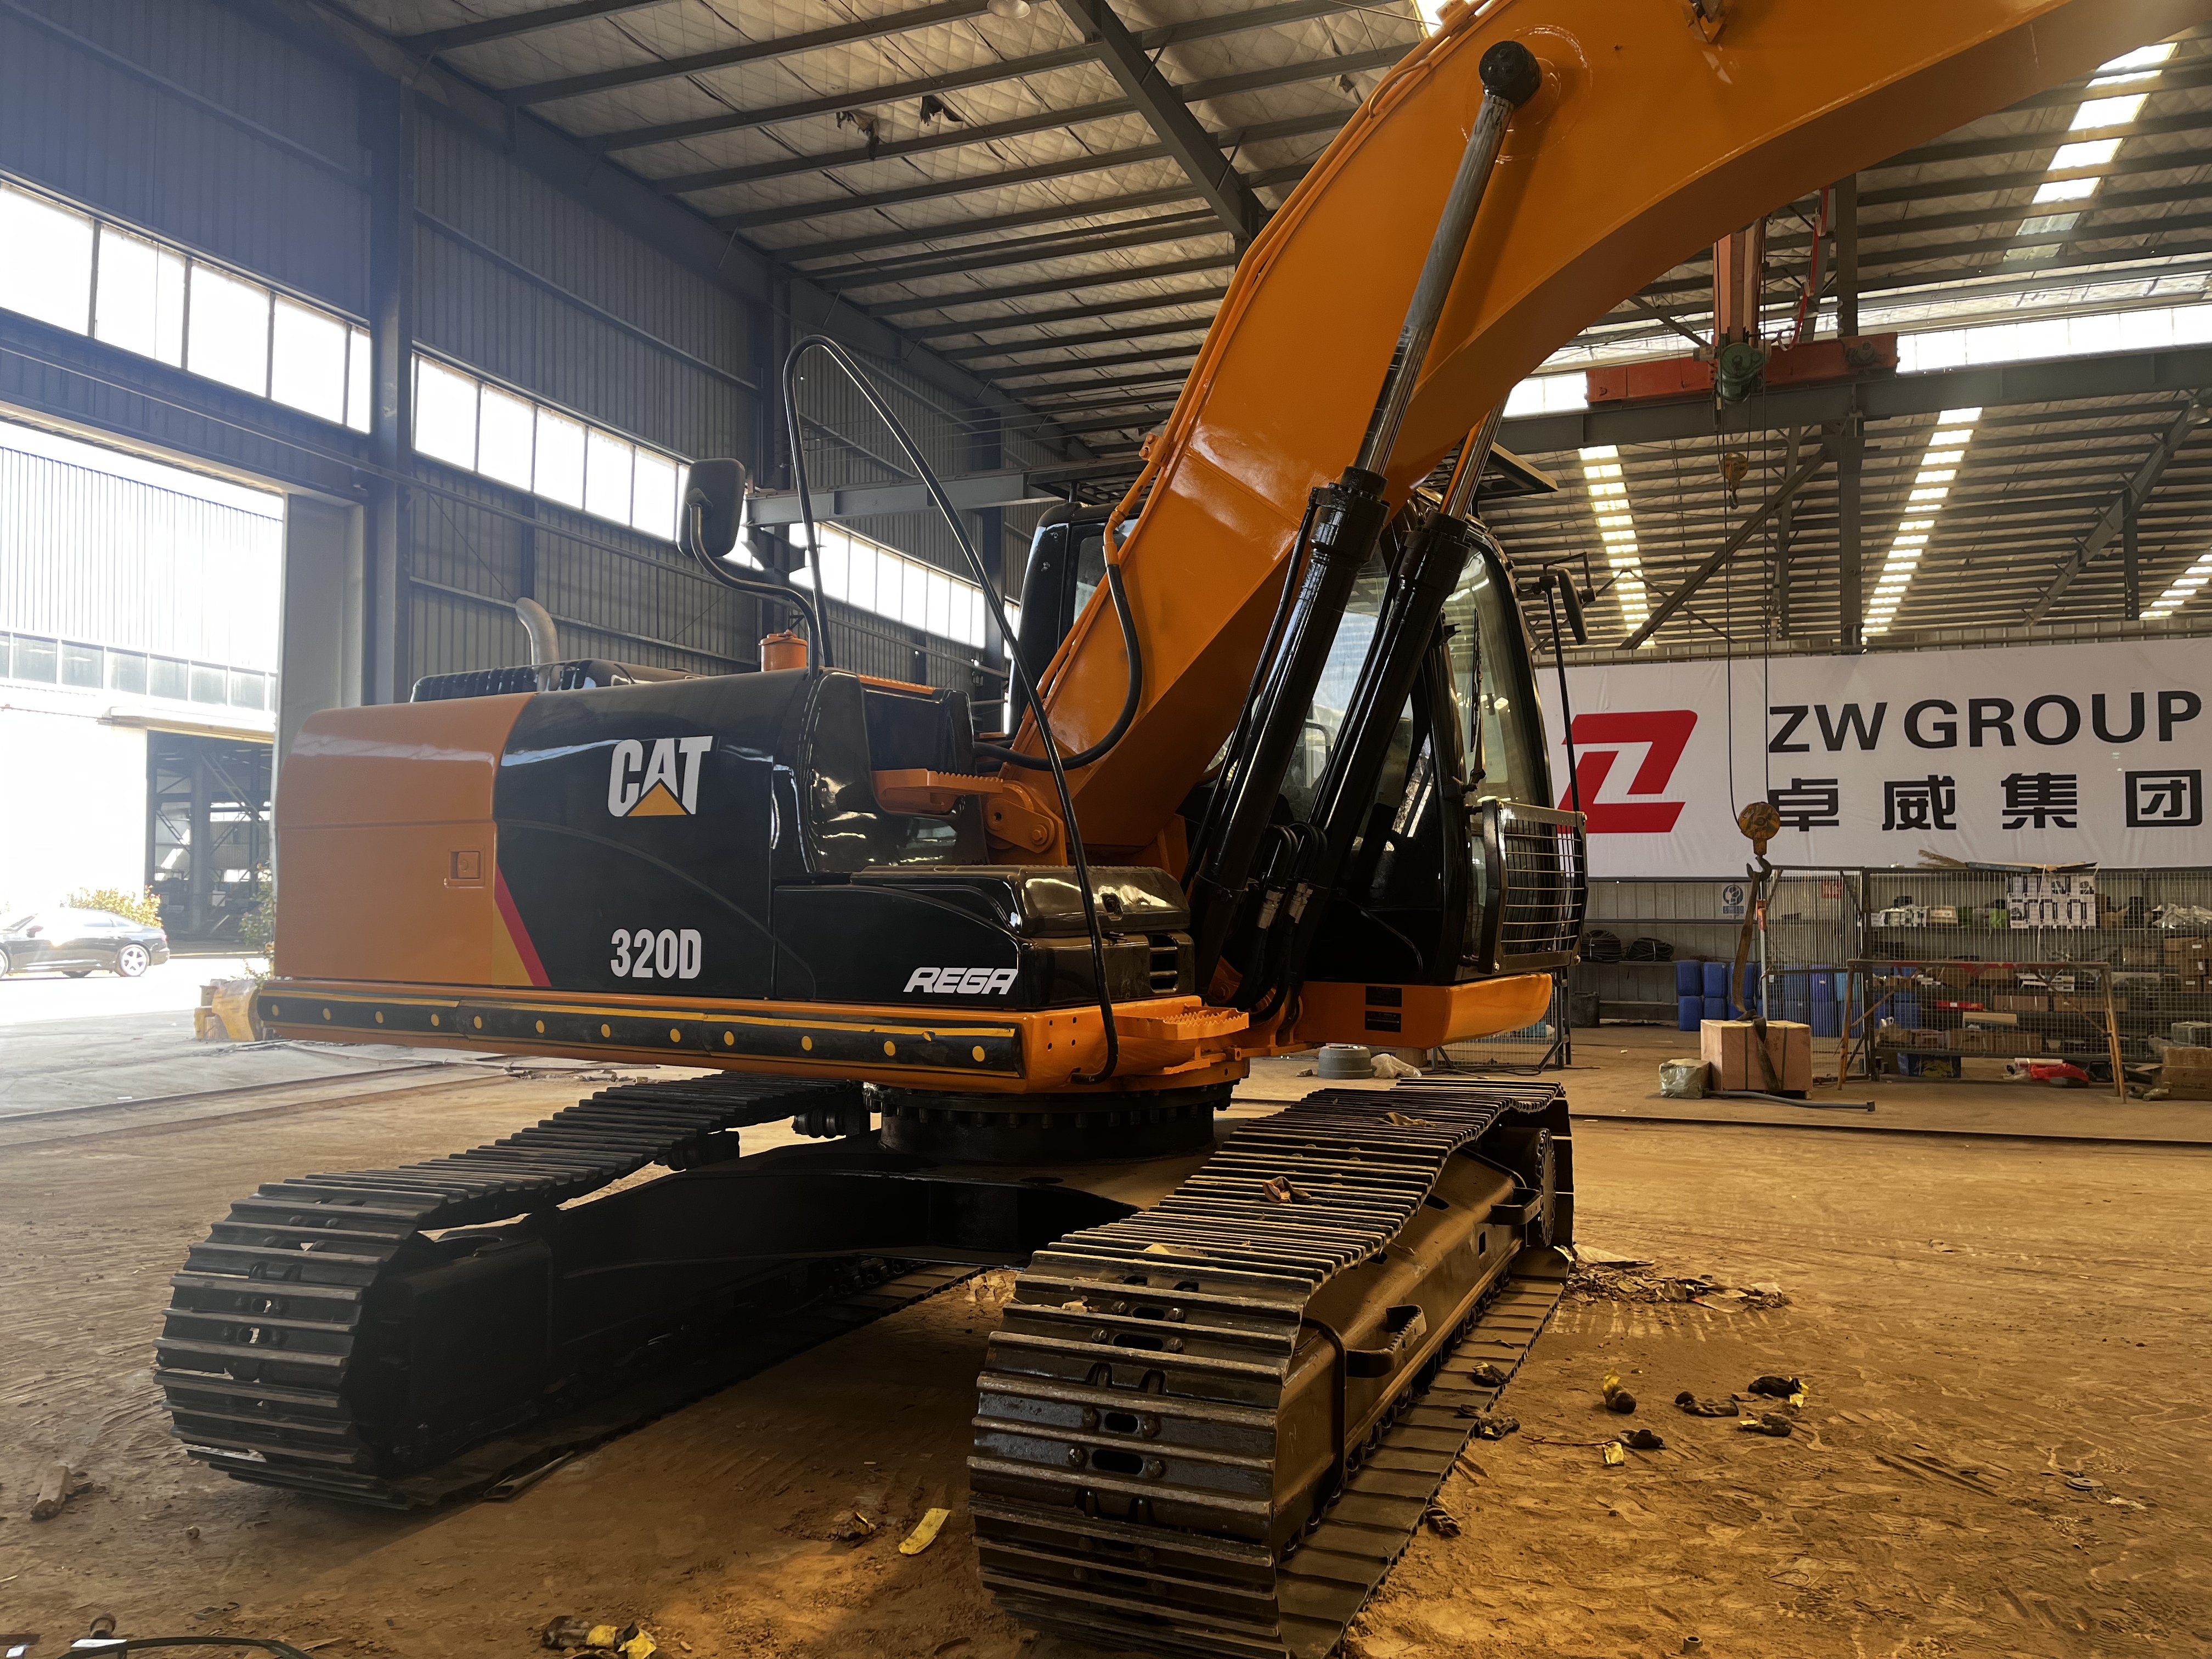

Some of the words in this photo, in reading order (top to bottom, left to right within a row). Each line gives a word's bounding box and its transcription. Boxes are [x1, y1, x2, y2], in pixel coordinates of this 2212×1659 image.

[1768, 701, 1888, 753] ZW
[1904, 690, 2203, 749] GROUP
[607, 736, 713, 817] CAT
[1768, 769, 2203, 832] 卓威集团
[610, 928, 702, 980] 320D
[902, 967, 1019, 995] REGA
